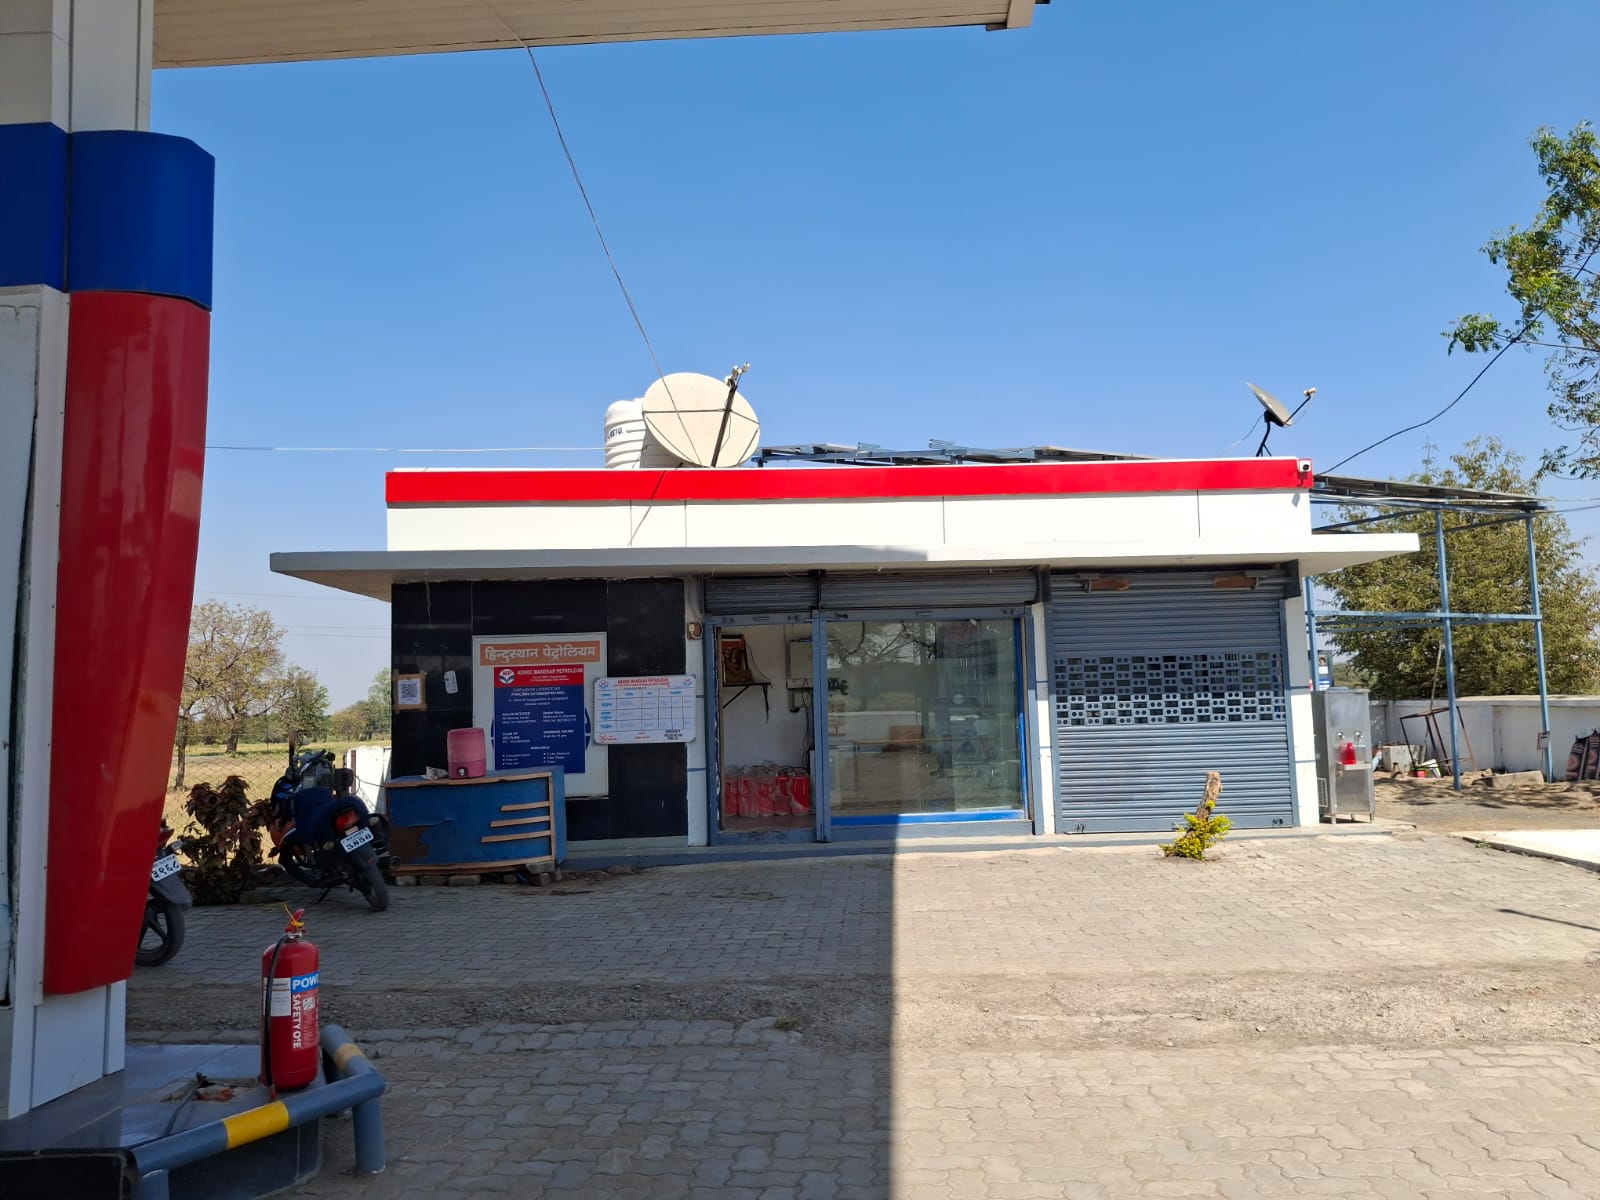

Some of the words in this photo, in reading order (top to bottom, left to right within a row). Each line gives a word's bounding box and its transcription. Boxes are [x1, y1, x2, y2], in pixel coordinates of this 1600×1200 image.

[485, 646, 538, 663] हिन्दुस्थान
[543, 644, 597, 660] पेट्रोलियम
[292, 993, 302, 1029] SAFETY
